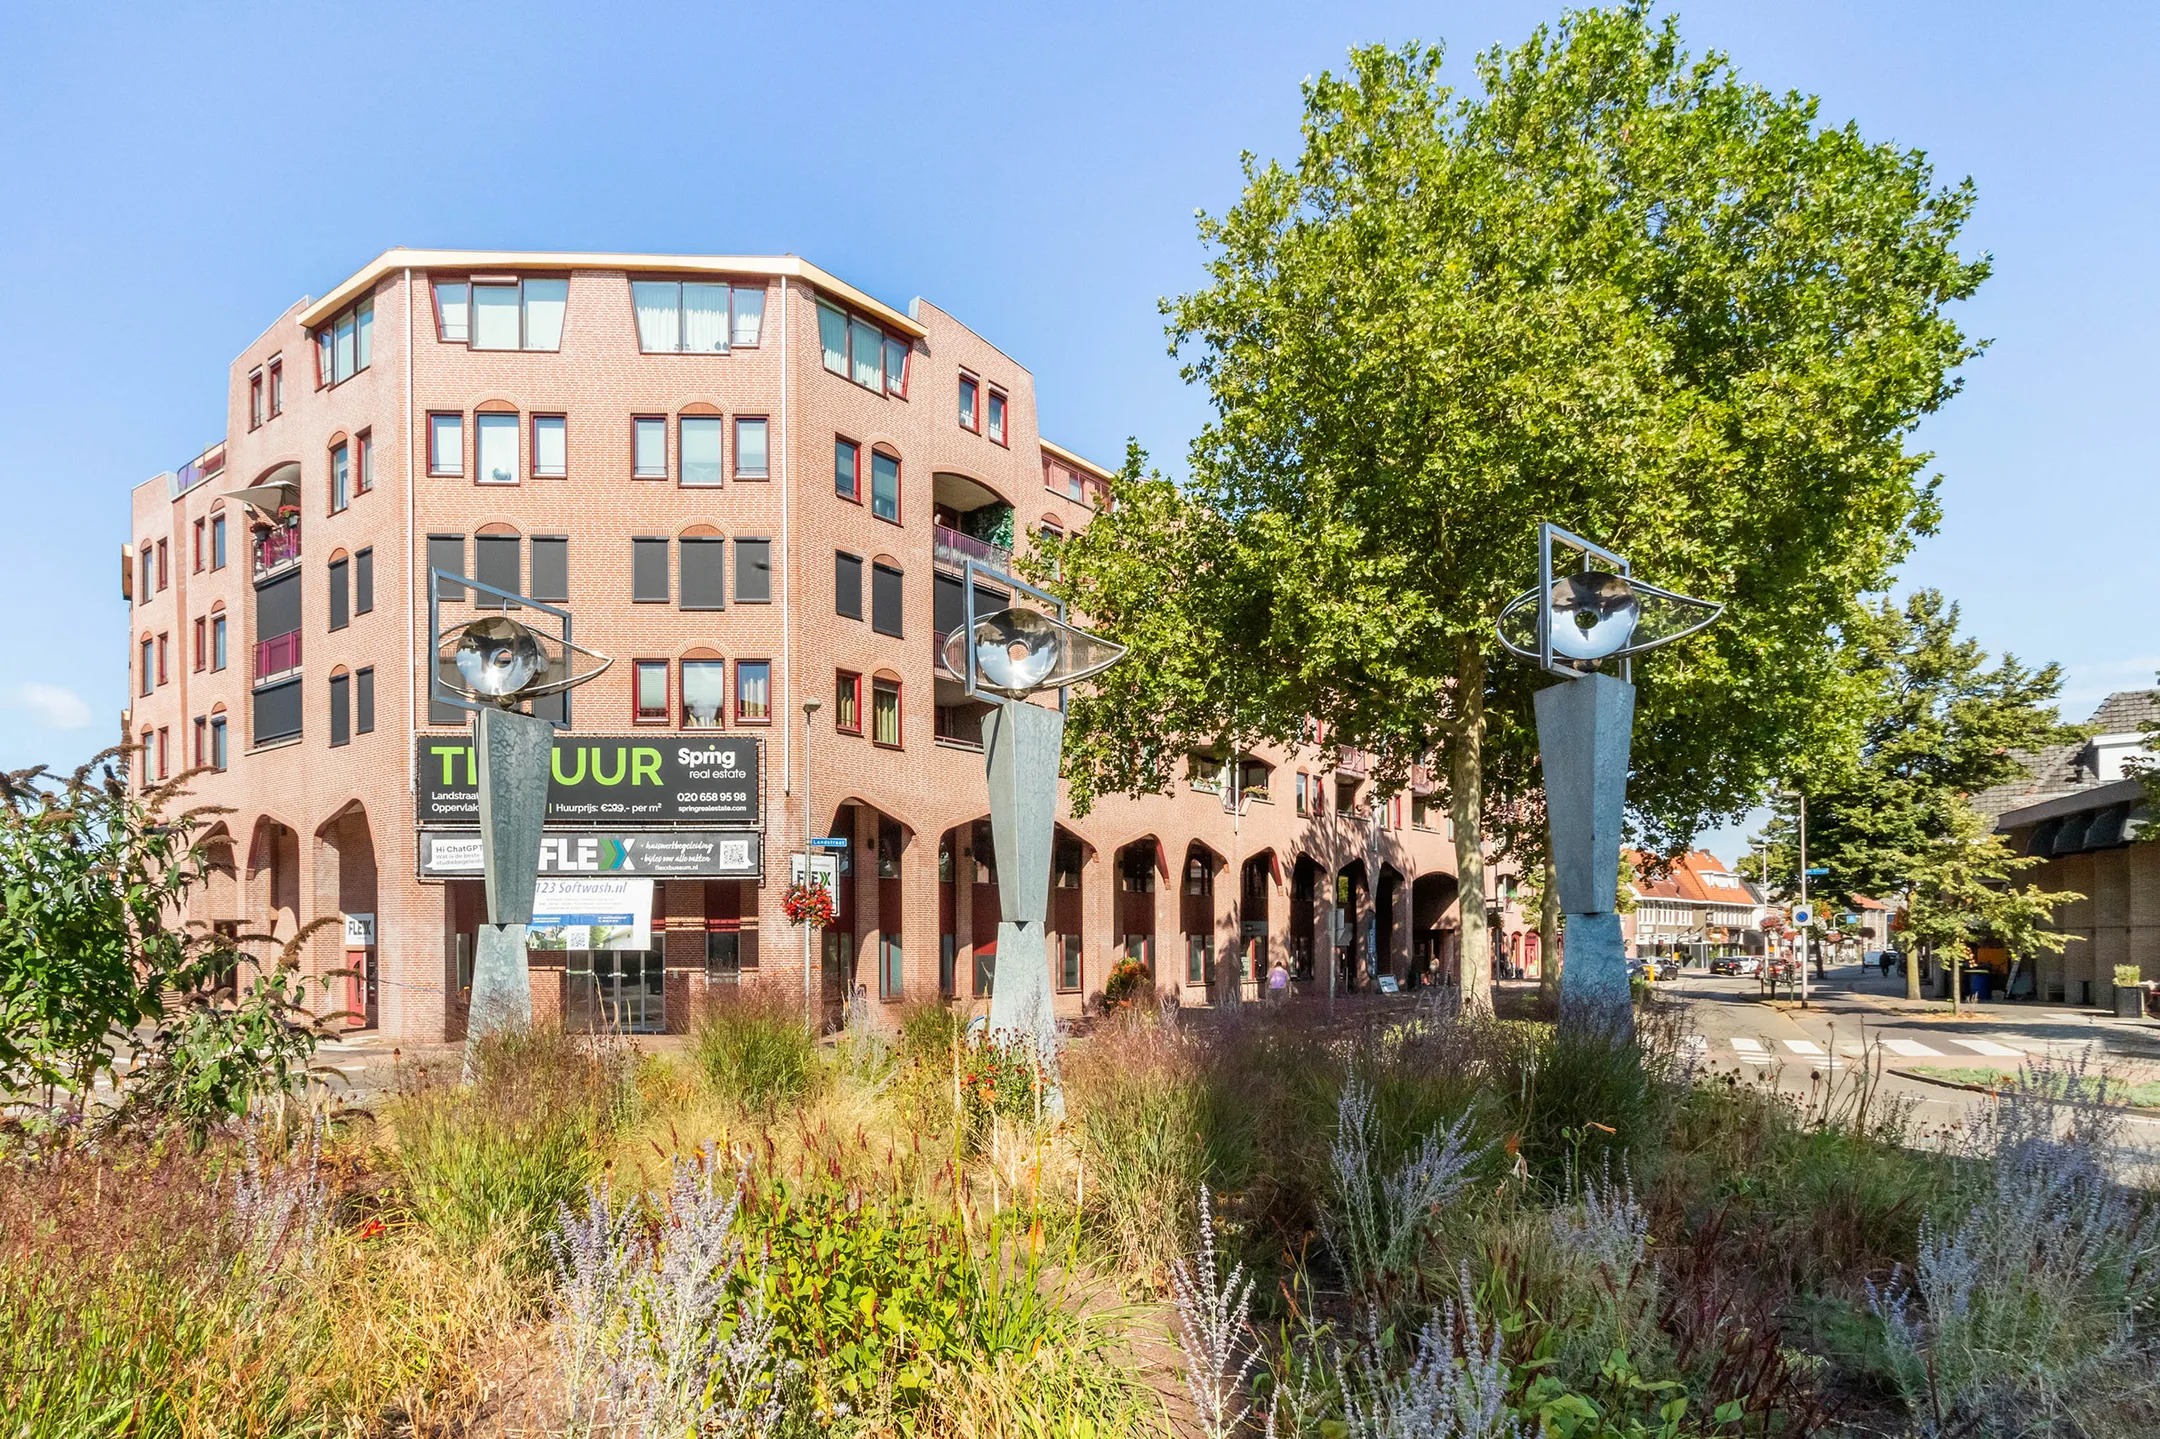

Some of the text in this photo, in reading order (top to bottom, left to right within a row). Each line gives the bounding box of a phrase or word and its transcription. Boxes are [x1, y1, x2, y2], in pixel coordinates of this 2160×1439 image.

[678, 744, 736, 769] Spring
[552, 747, 664, 786] UUR
[689, 769, 747, 779] real estate
[677, 792, 747, 802] 020 658 95 98
[431, 803, 479, 813] Oppervlak
[556, 803, 599, 814] Huurprijs:
[632, 805, 647, 814] per
[678, 805, 747, 813] springrealestate.com
[536, 881, 628, 894] 123 Softwash.nl
